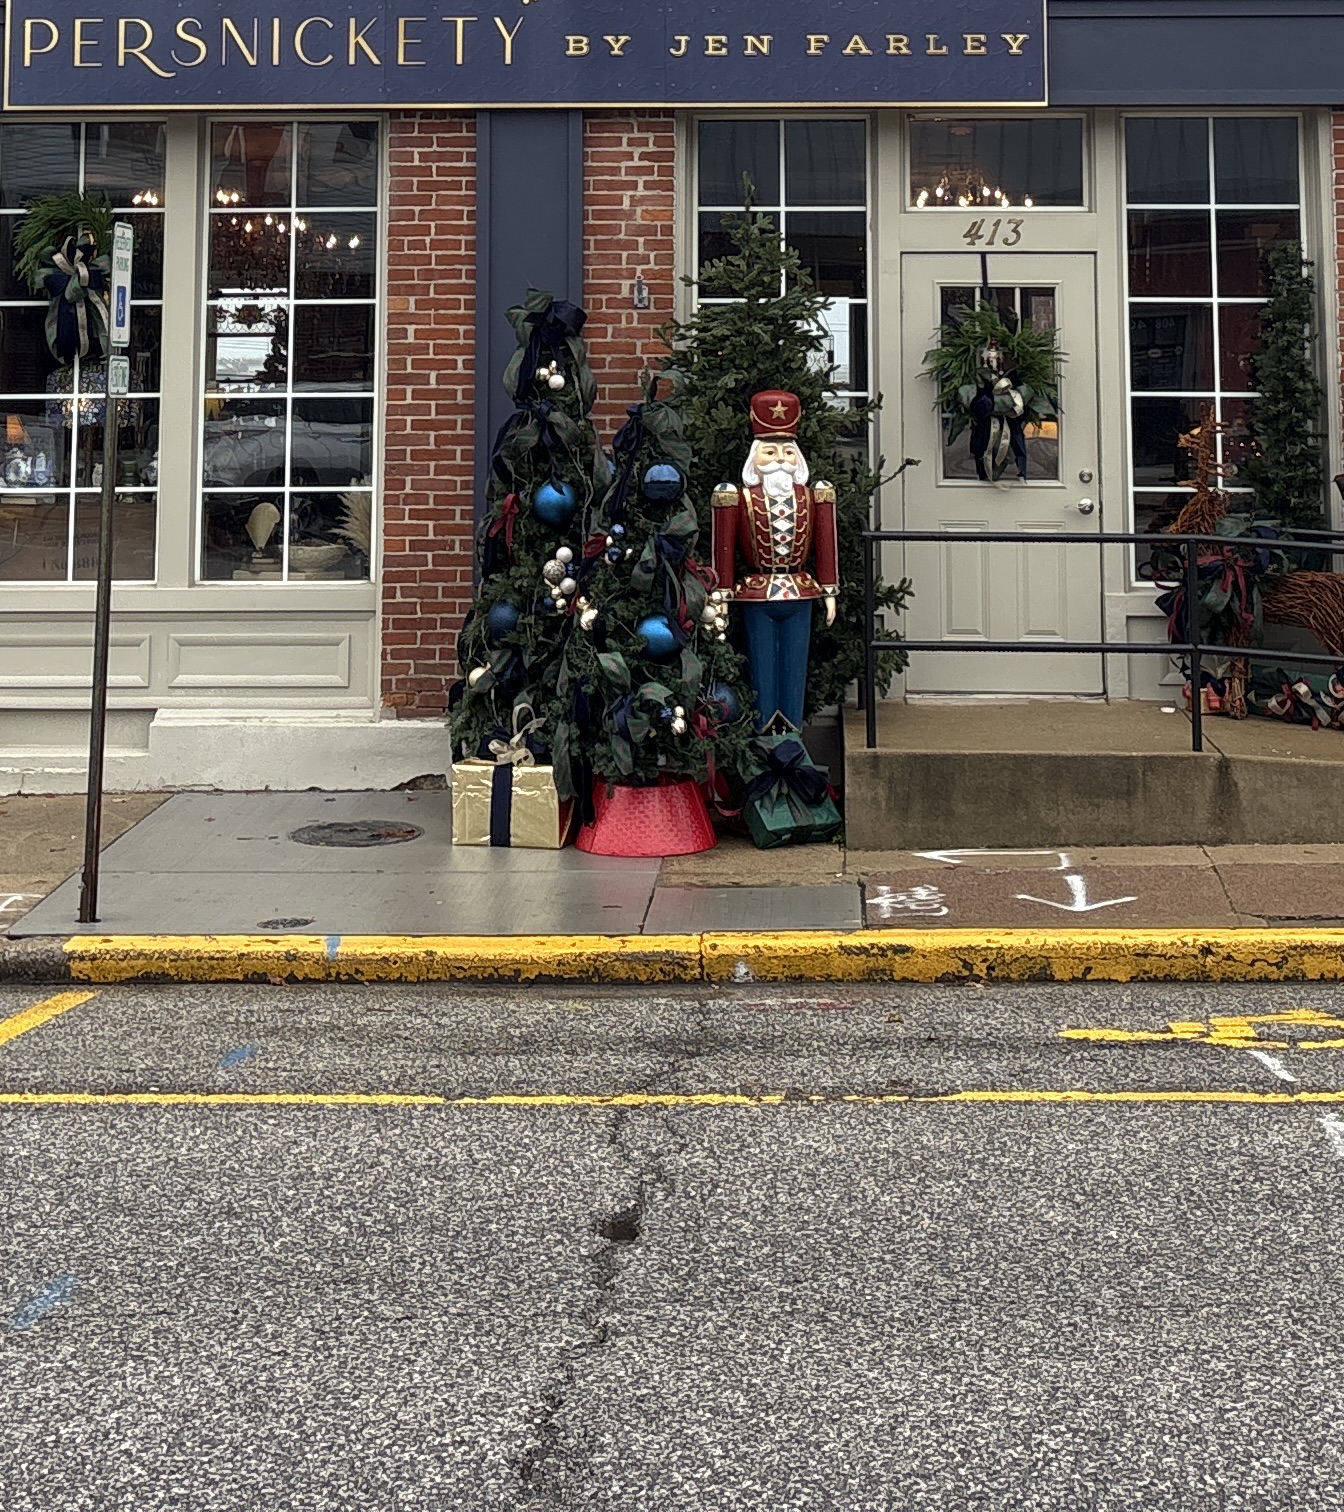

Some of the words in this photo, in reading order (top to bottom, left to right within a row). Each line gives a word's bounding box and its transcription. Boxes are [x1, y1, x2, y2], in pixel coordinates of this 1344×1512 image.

[22, 16, 525, 78] PERSNICKETY
[564, 34, 632, 57] BY
[668, 34, 774, 57] JEN
[805, 33, 1031, 57] FARLEY
[962, 218, 1025, 247] 413
